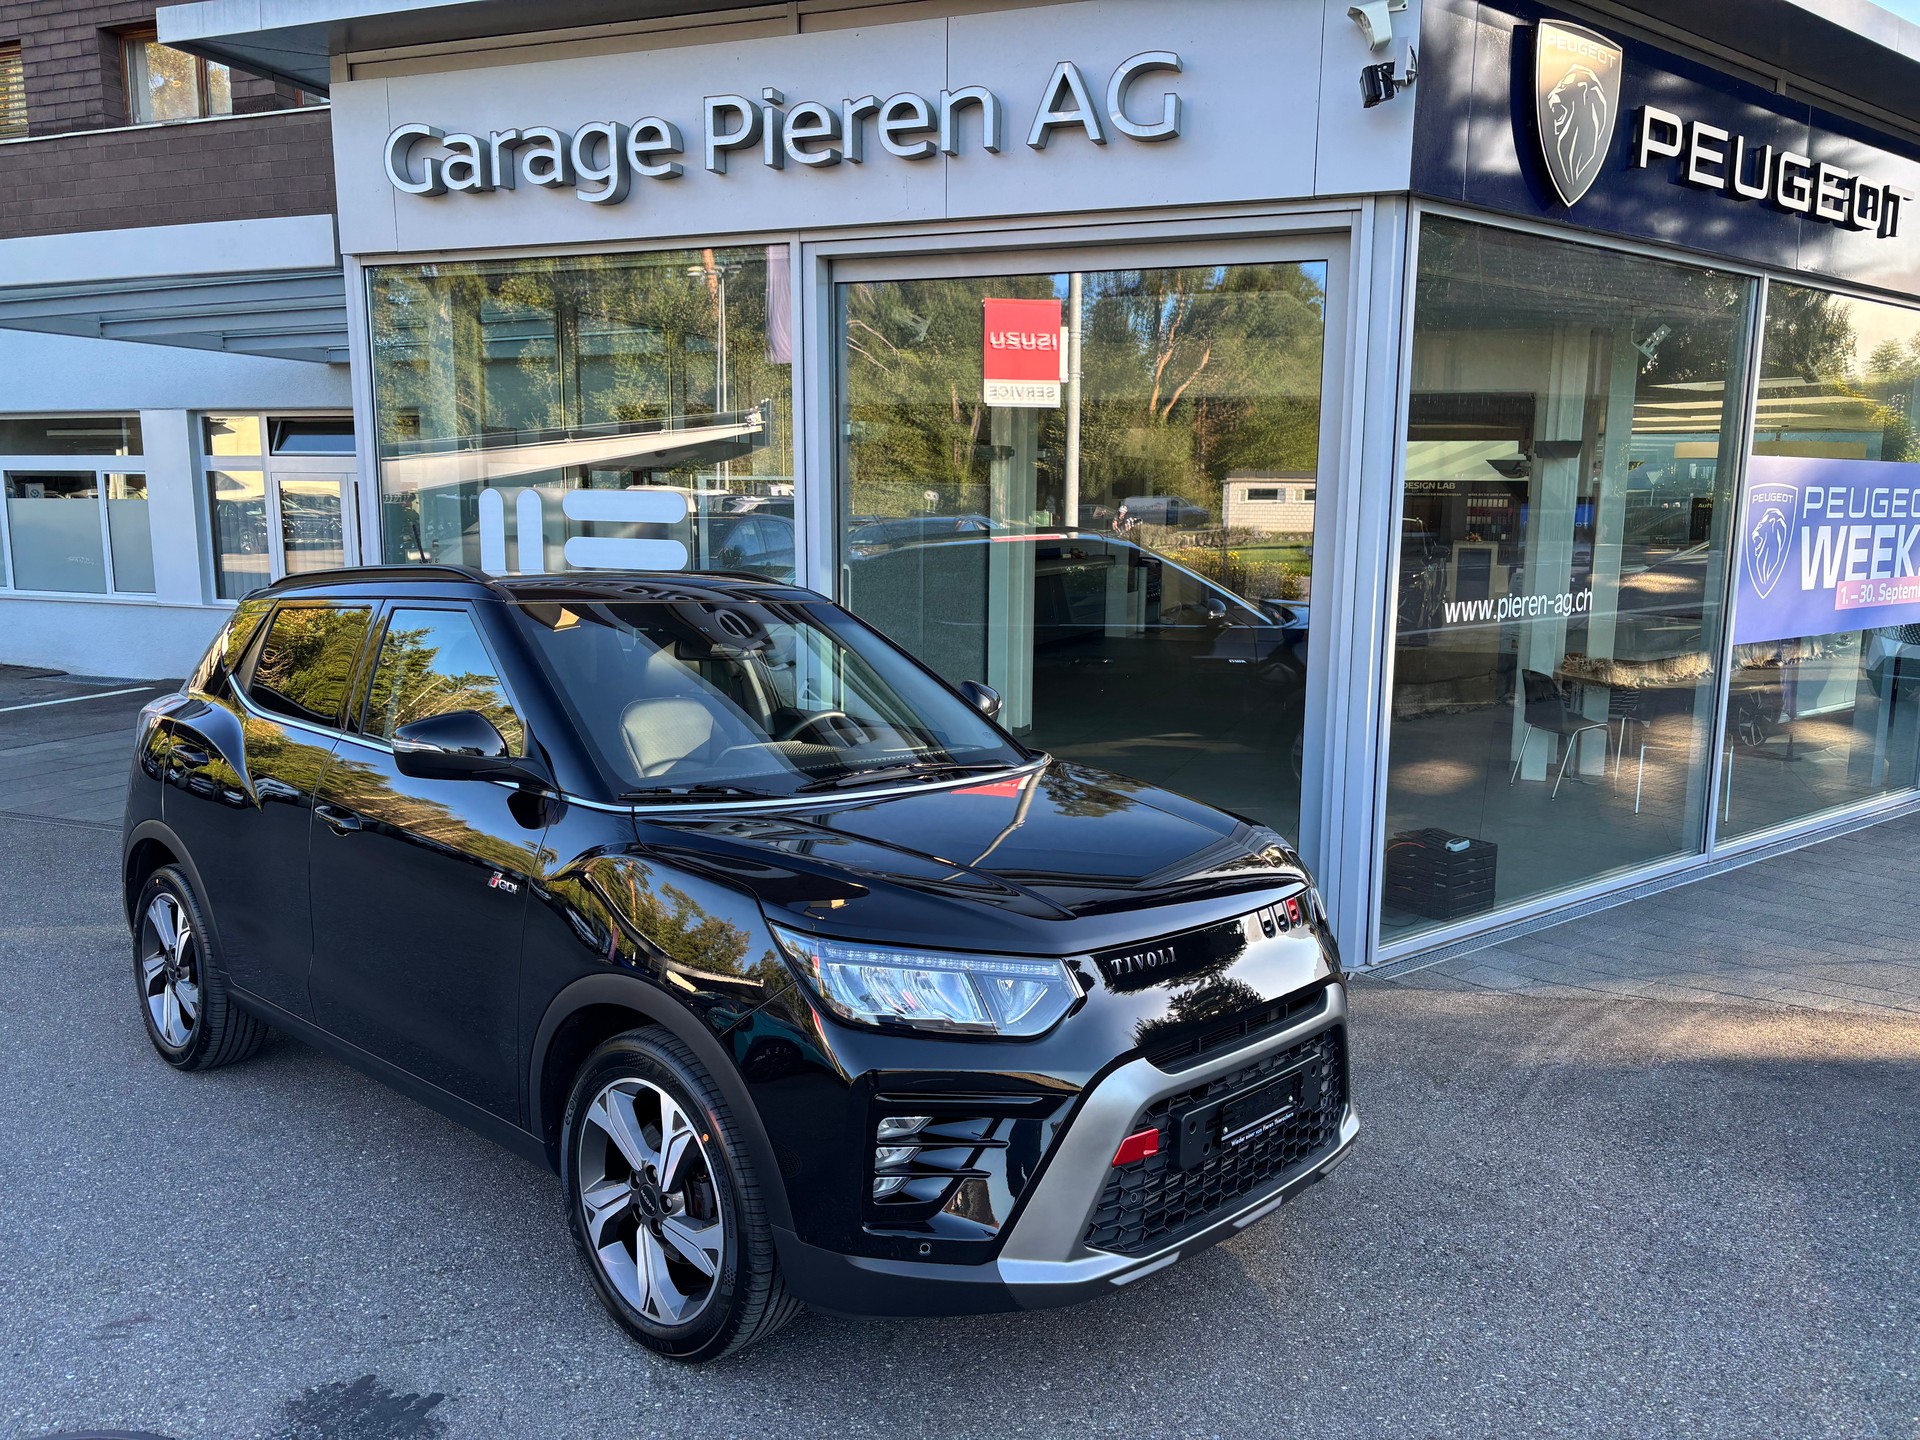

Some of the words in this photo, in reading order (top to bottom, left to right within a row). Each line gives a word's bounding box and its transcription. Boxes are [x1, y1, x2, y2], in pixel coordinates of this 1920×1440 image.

[384, 114, 683, 205] Garage
[704, 84, 1000, 174] Pieren
[1026, 50, 1183, 150] AG
[1637, 104, 1915, 239] PEUGEOT
[1437, 482, 1456, 490] LAB
[1752, 492, 1794, 504] PEUGEOT
[1801, 524, 1920, 591] WEEK
[1444, 588, 1593, 624] www.pieren-ag.ch
[1878, 582, 1920, 604] Septem
[1111, 946, 1176, 976] TIVOLI
